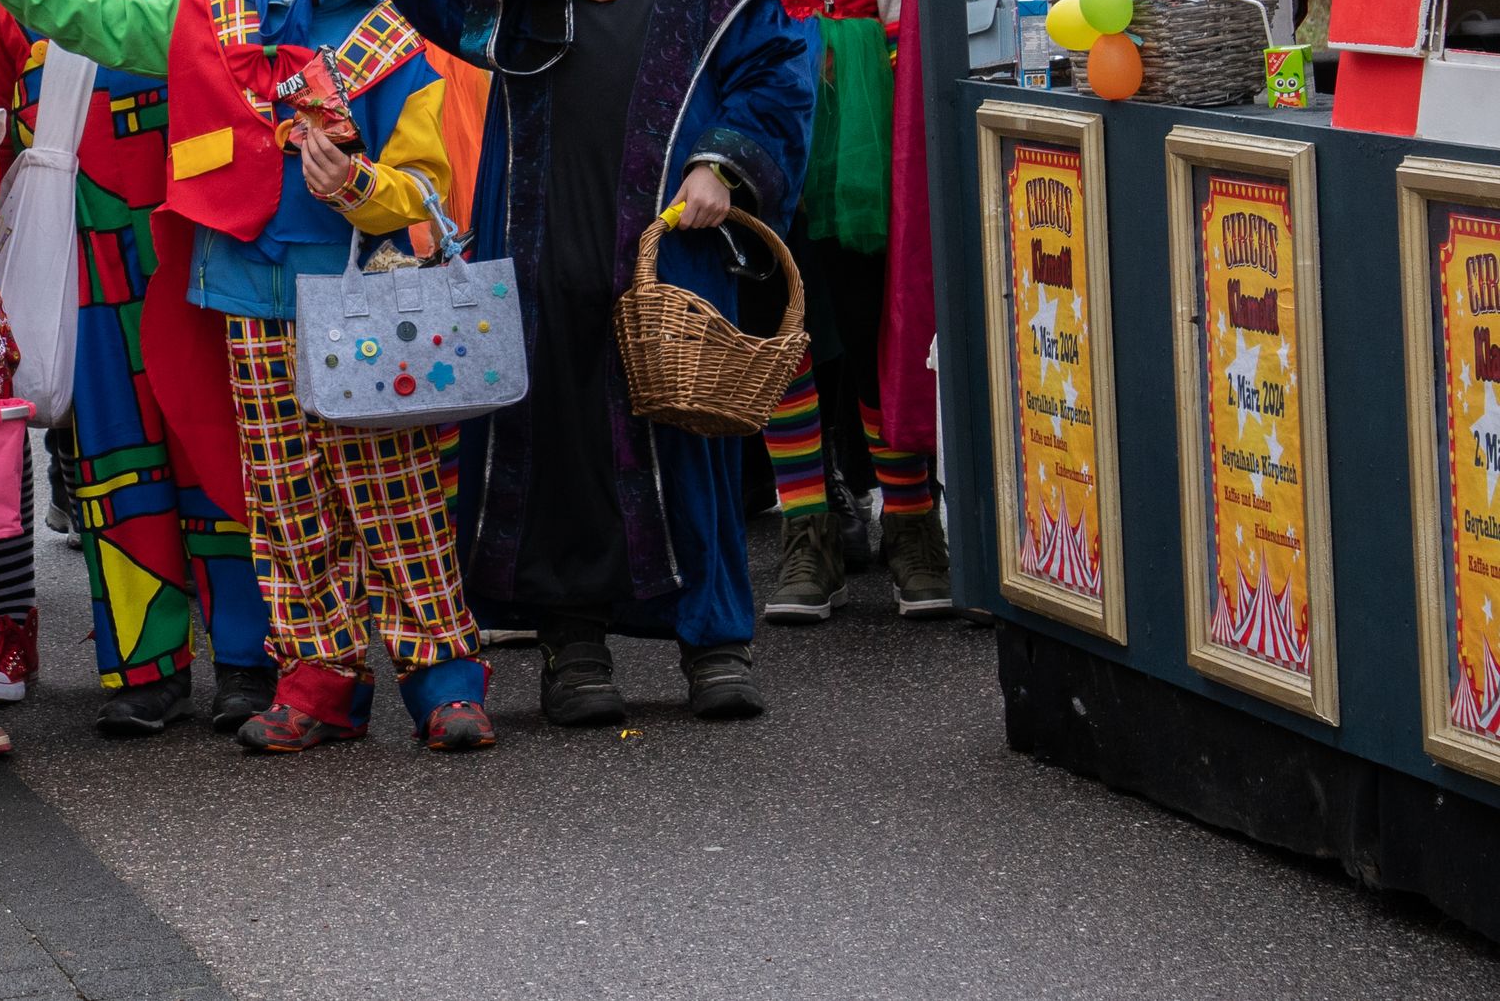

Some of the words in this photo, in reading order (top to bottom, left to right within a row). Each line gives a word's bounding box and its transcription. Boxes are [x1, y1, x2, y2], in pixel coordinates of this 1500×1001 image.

[1025, 177, 1073, 237] CIRCUS
[1221, 212, 1278, 278] CIRCUS
[1040, 324, 1059, 362] März
[1060, 330, 1080, 366] 2024
[1059, 399, 1092, 427] Körperich
[1237, 373, 1261, 414] März
[1262, 380, 1285, 418] 2024
[1261, 454, 1298, 485] Körperich
